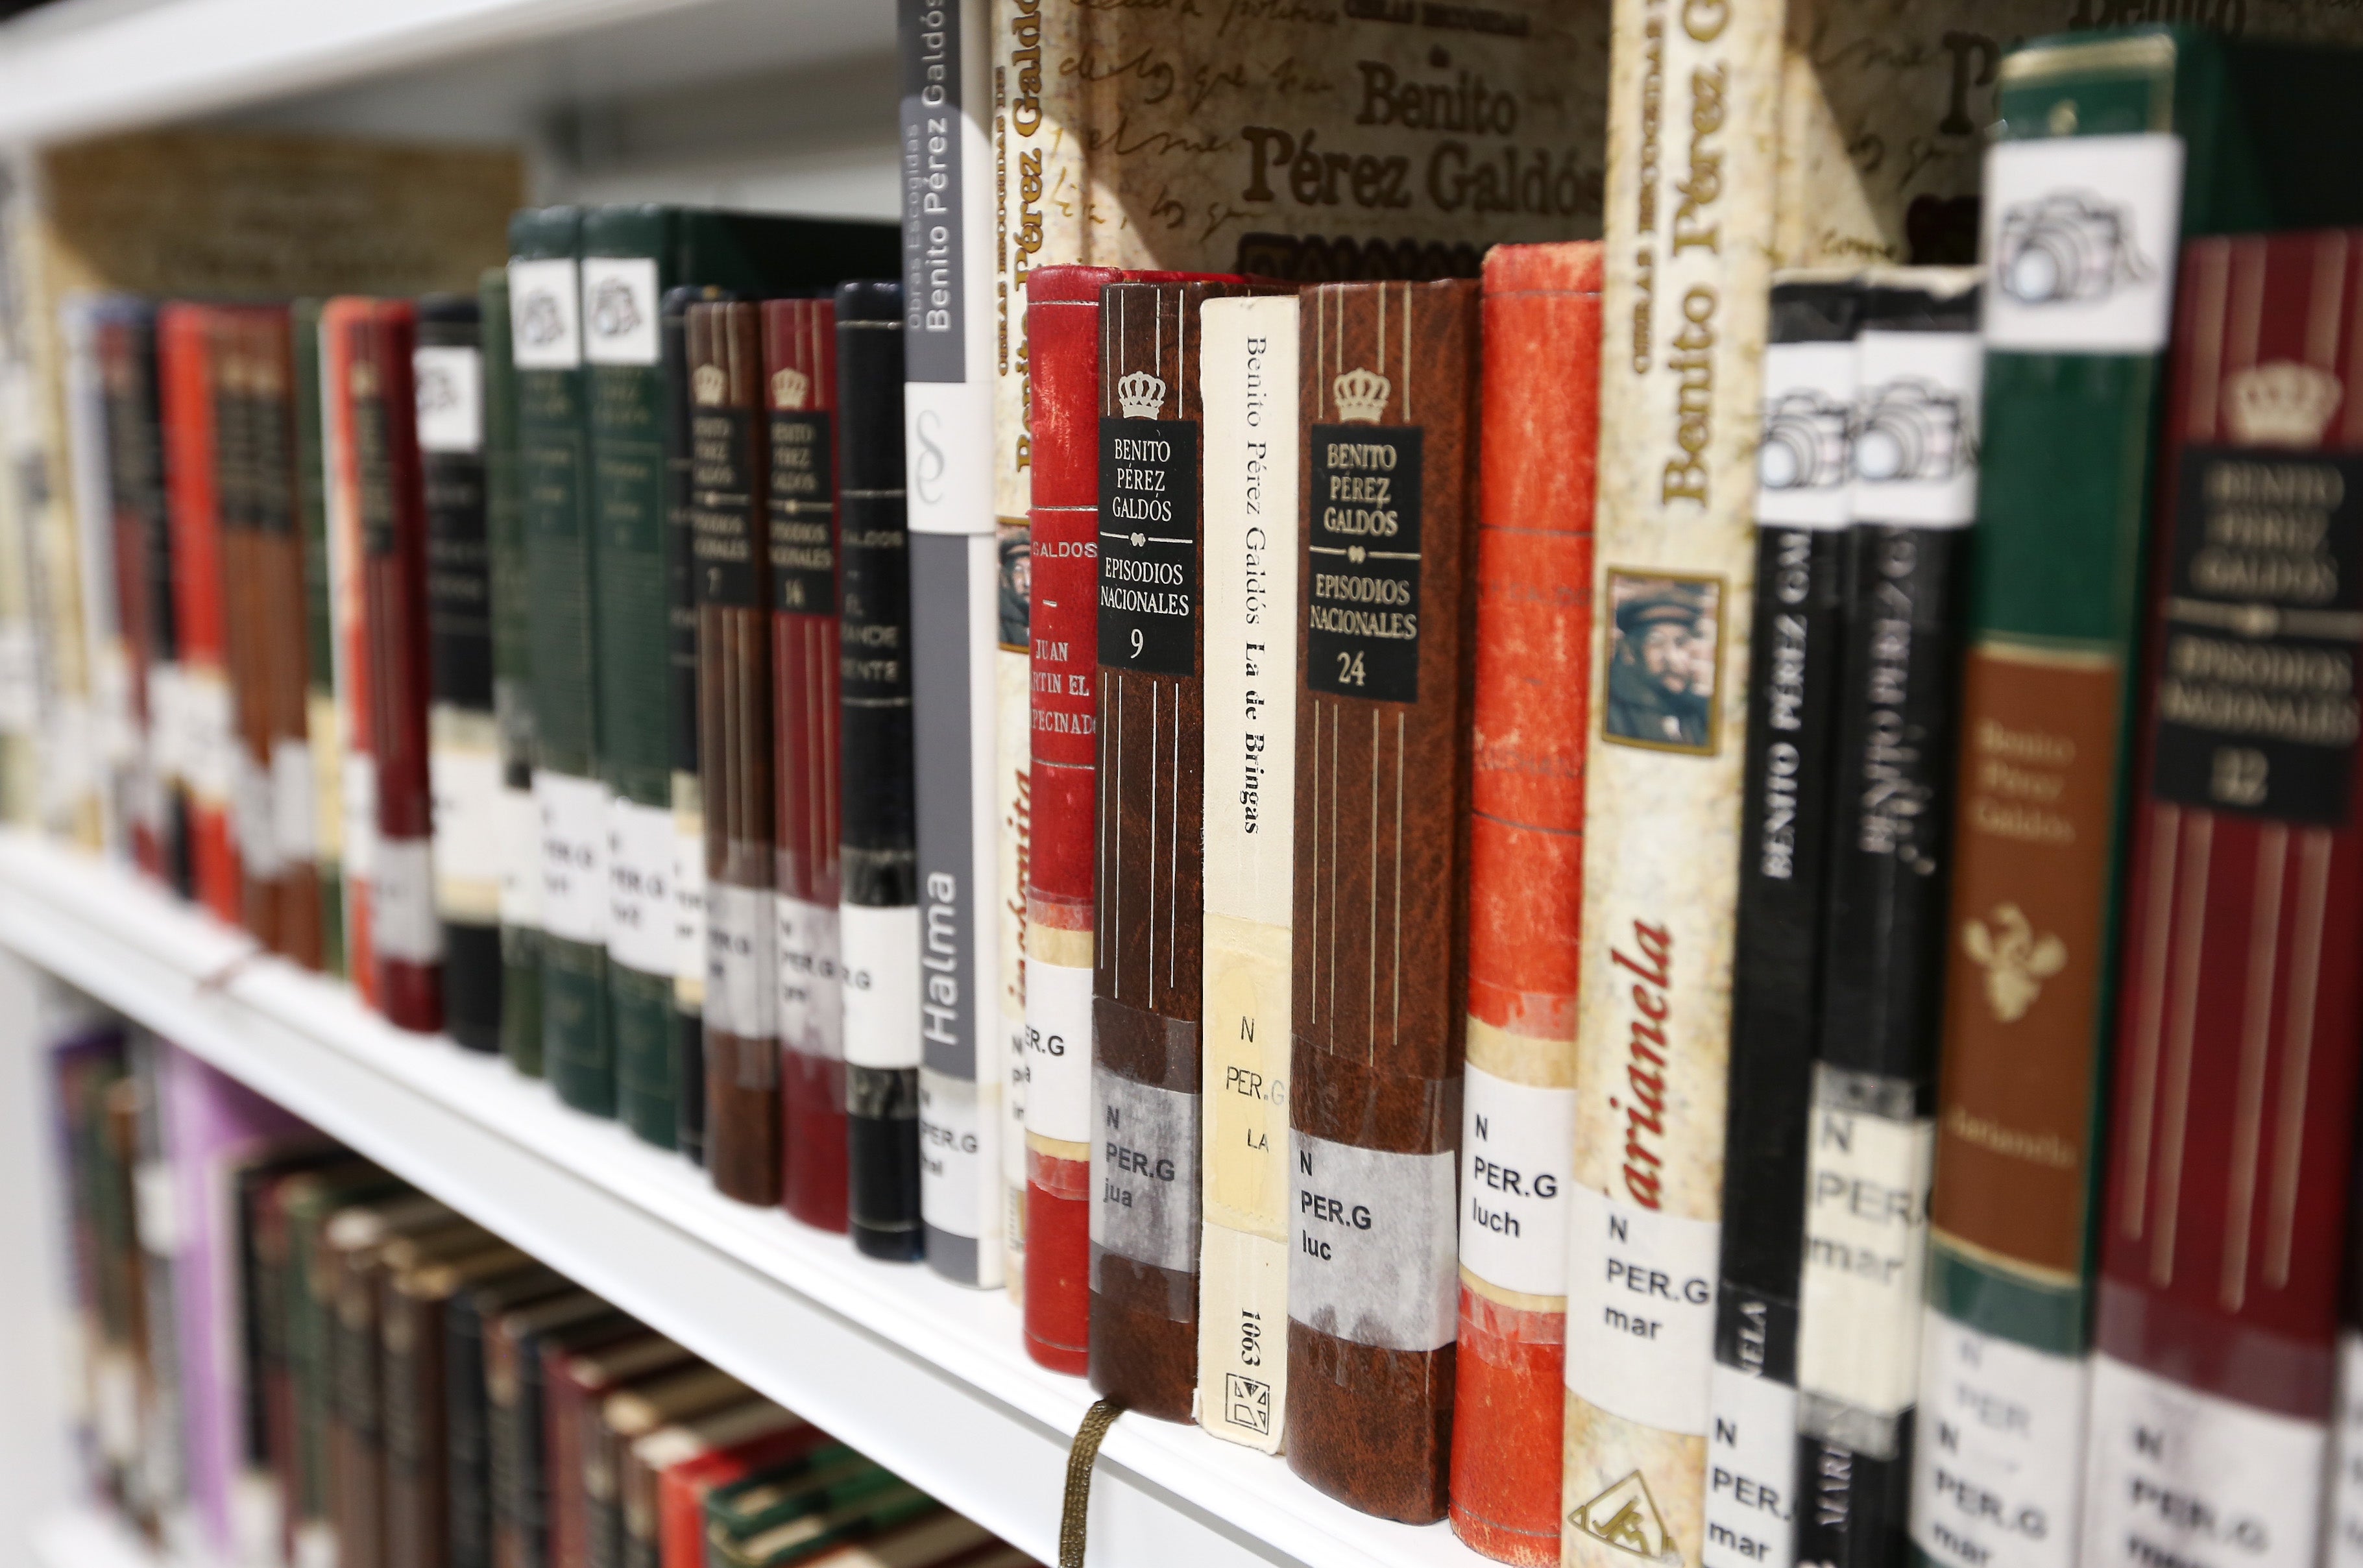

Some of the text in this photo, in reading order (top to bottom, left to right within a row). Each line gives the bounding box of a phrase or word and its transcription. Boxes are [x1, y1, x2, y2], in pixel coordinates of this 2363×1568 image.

[1356, 60, 1519, 134] Benito
[921, 117, 949, 214] Pérez
[1241, 125, 1412, 208] Pérez
[1671, 60, 1727, 257] Pérez
[924, 224, 951, 332] Benito
[1661, 285, 1716, 508] Benito
[1114, 438, 1171, 463] BENITO
[1327, 443, 1397, 471] BENITO
[1117, 463, 1166, 492] PÉREZ
[1329, 471, 1391, 505] PÉREZ
[1112, 492, 1172, 522] GALDÓS
[1324, 504, 1399, 538] GALDÓS
[1105, 556, 1184, 586] EPISODIOS
[1239, 336, 1267, 835] Benito Pérez Galdós La de Bringas
[1100, 585, 1190, 617] NACIONALES
[1315, 573, 1411, 607] EPISODIOS
[1309, 604, 1418, 641] NACIONALES
[1036, 638, 1069, 662] JUAN
[1130, 627, 1144, 659] 9
[1337, 649, 1366, 687] 24
[1069, 675, 1090, 697] EL
[1032, 708, 1096, 734] PECINAD
[1760, 742, 1800, 879] BENITO
[922, 871, 957, 1046] Halma
[1240, 1015, 1255, 1043] N
[1226, 1065, 1286, 1105] PER.G
[1106, 1105, 1120, 1131] N
[1475, 1113, 1488, 1142] N
[1821, 1113, 1854, 1153] N
[1246, 1128, 1270, 1154] LA
[1106, 1142, 1175, 1182] PER.G
[1300, 1150, 1313, 1177] N
[1474, 1155, 1558, 1199] PER.G
[1103, 1177, 1132, 1208] jua
[1301, 1189, 1372, 1230] PER.G
[1473, 1197, 1521, 1239] luch
[1609, 1213, 1628, 1245] N
[1302, 1229, 1332, 1261] luc
[1808, 1236, 1905, 1287] mar
[1606, 1257, 1711, 1305] PER.G
[1241, 1307, 1262, 1367] 1063
[1604, 1306, 1664, 1341] mar
[1715, 1417, 1737, 1448] N
[1938, 1419, 1959, 1453] N
[1708, 1521, 1773, 1563] mar
